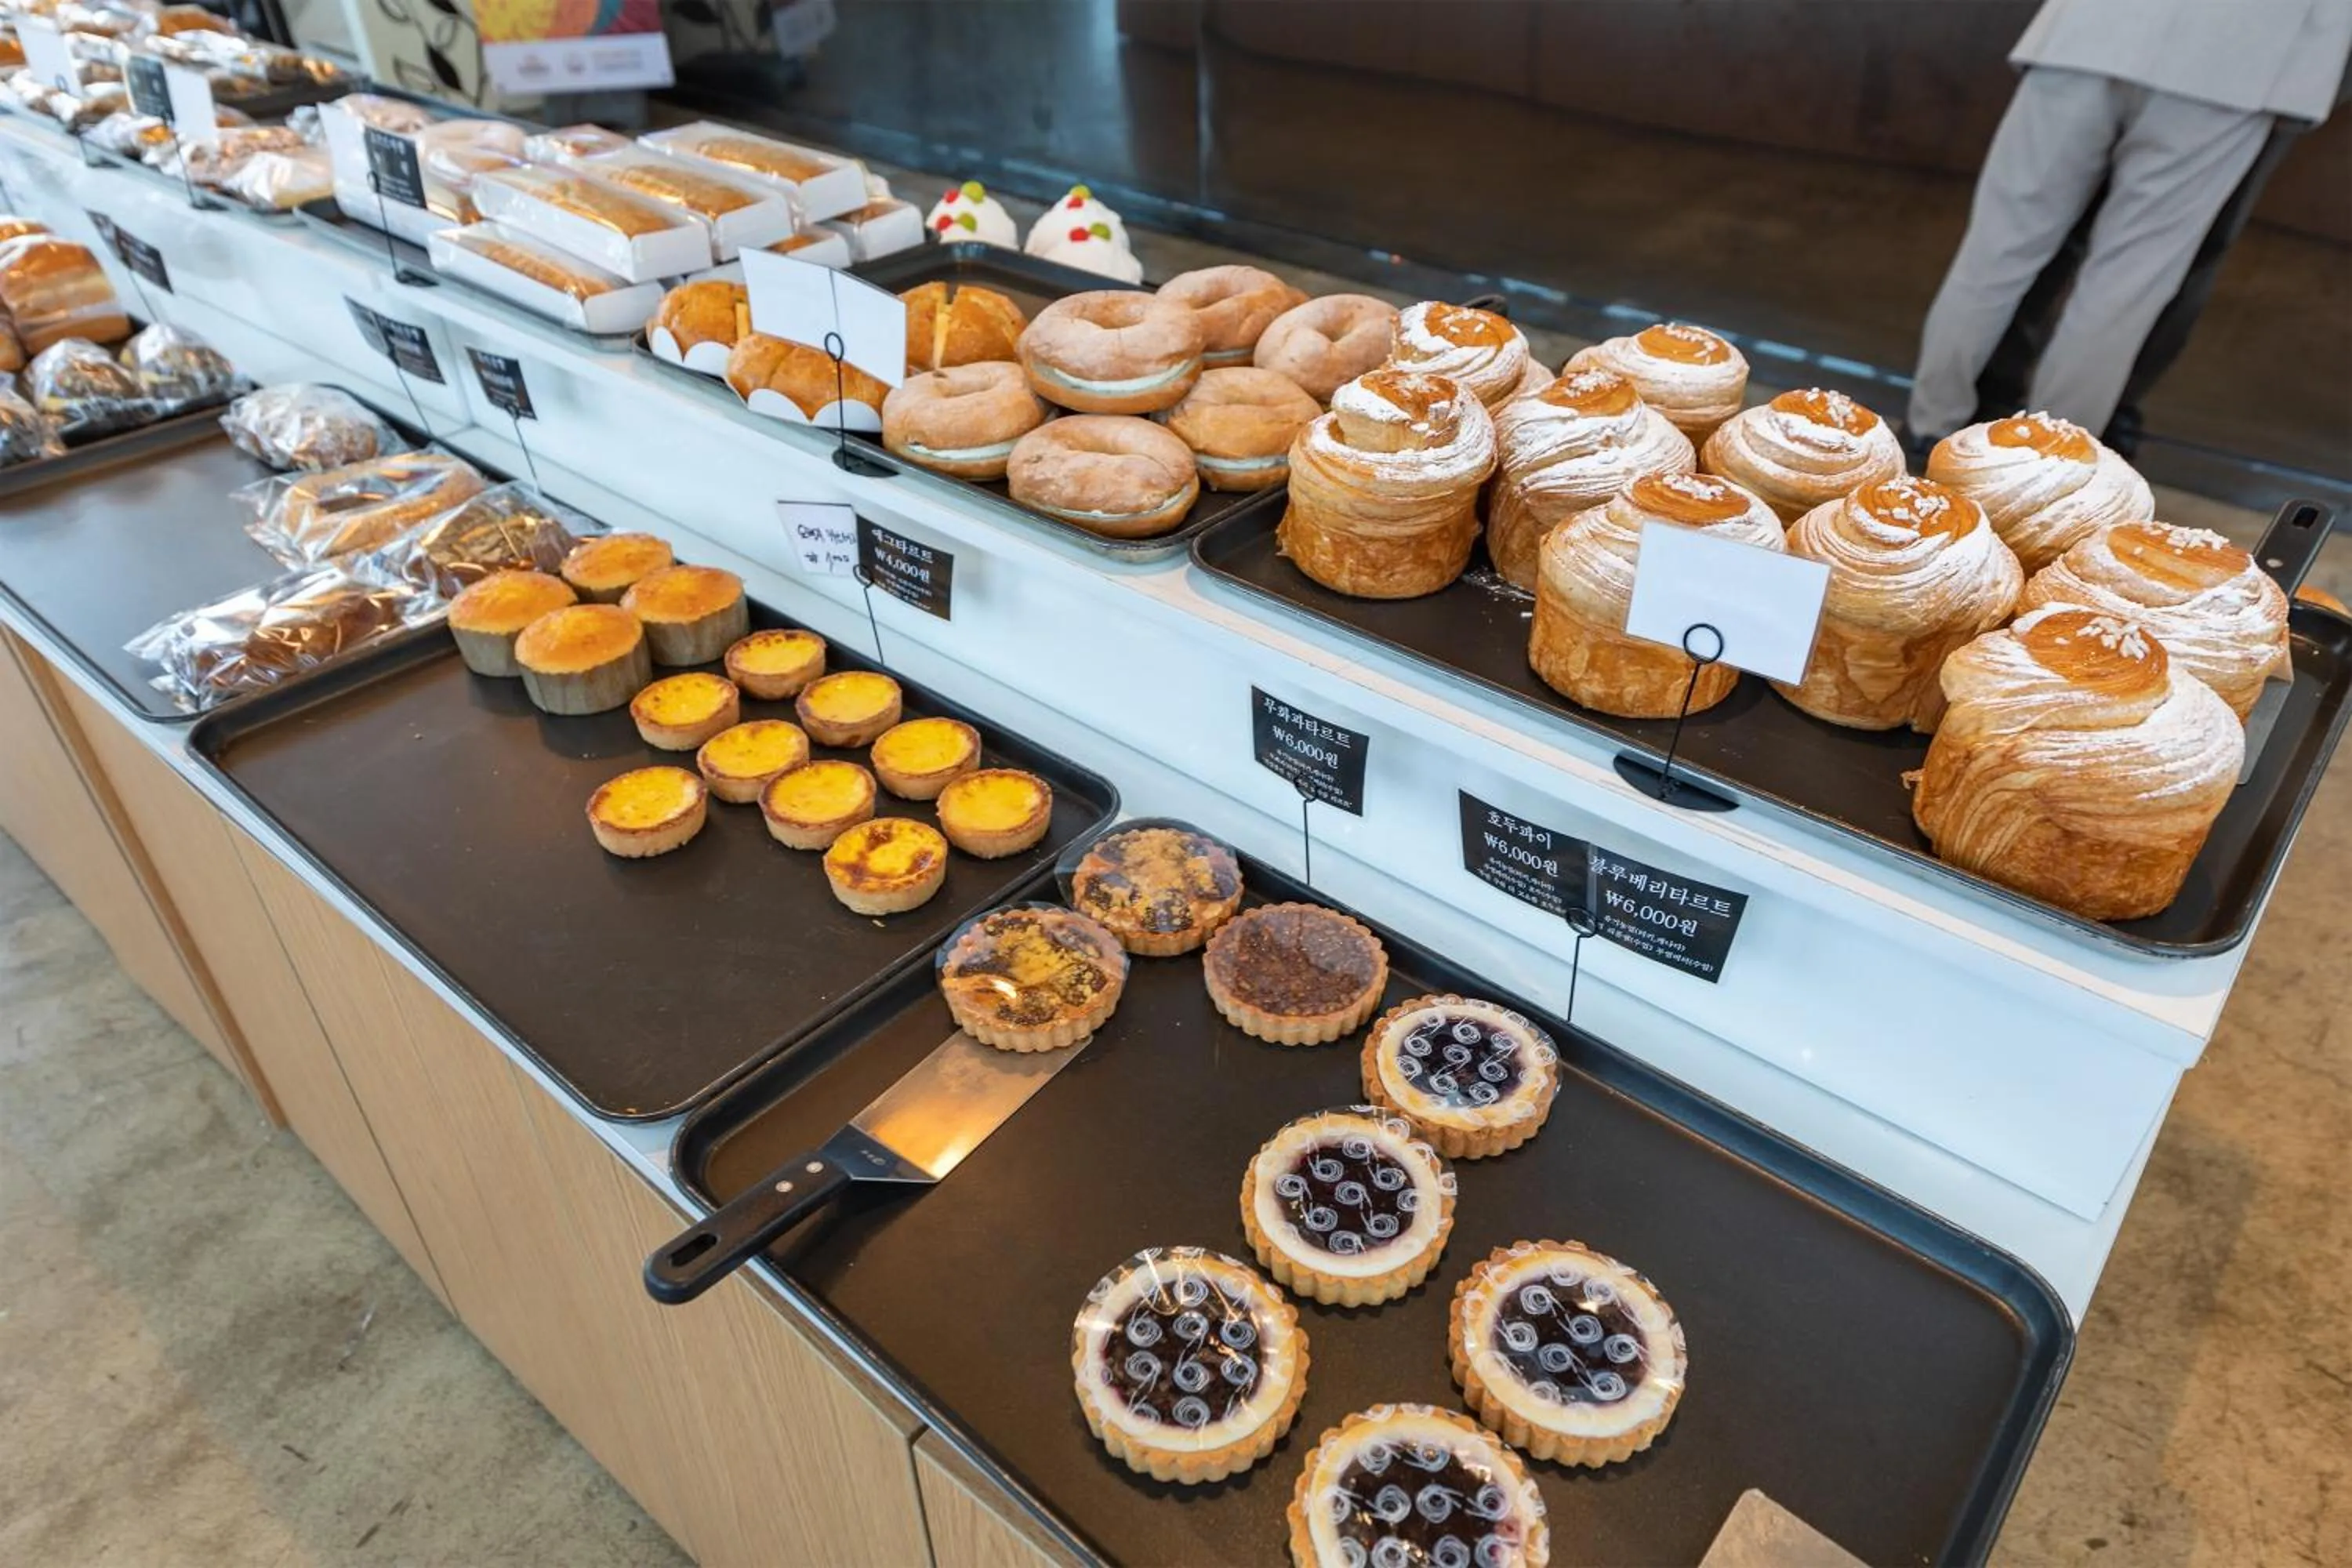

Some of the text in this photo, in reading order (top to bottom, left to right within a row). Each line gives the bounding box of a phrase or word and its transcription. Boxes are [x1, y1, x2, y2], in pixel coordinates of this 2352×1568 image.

[1263, 697, 1351, 749] 무화과타르트
[1487, 810, 1552, 851] 호두파이
[1590, 855, 1731, 918] 블루베리타르트
